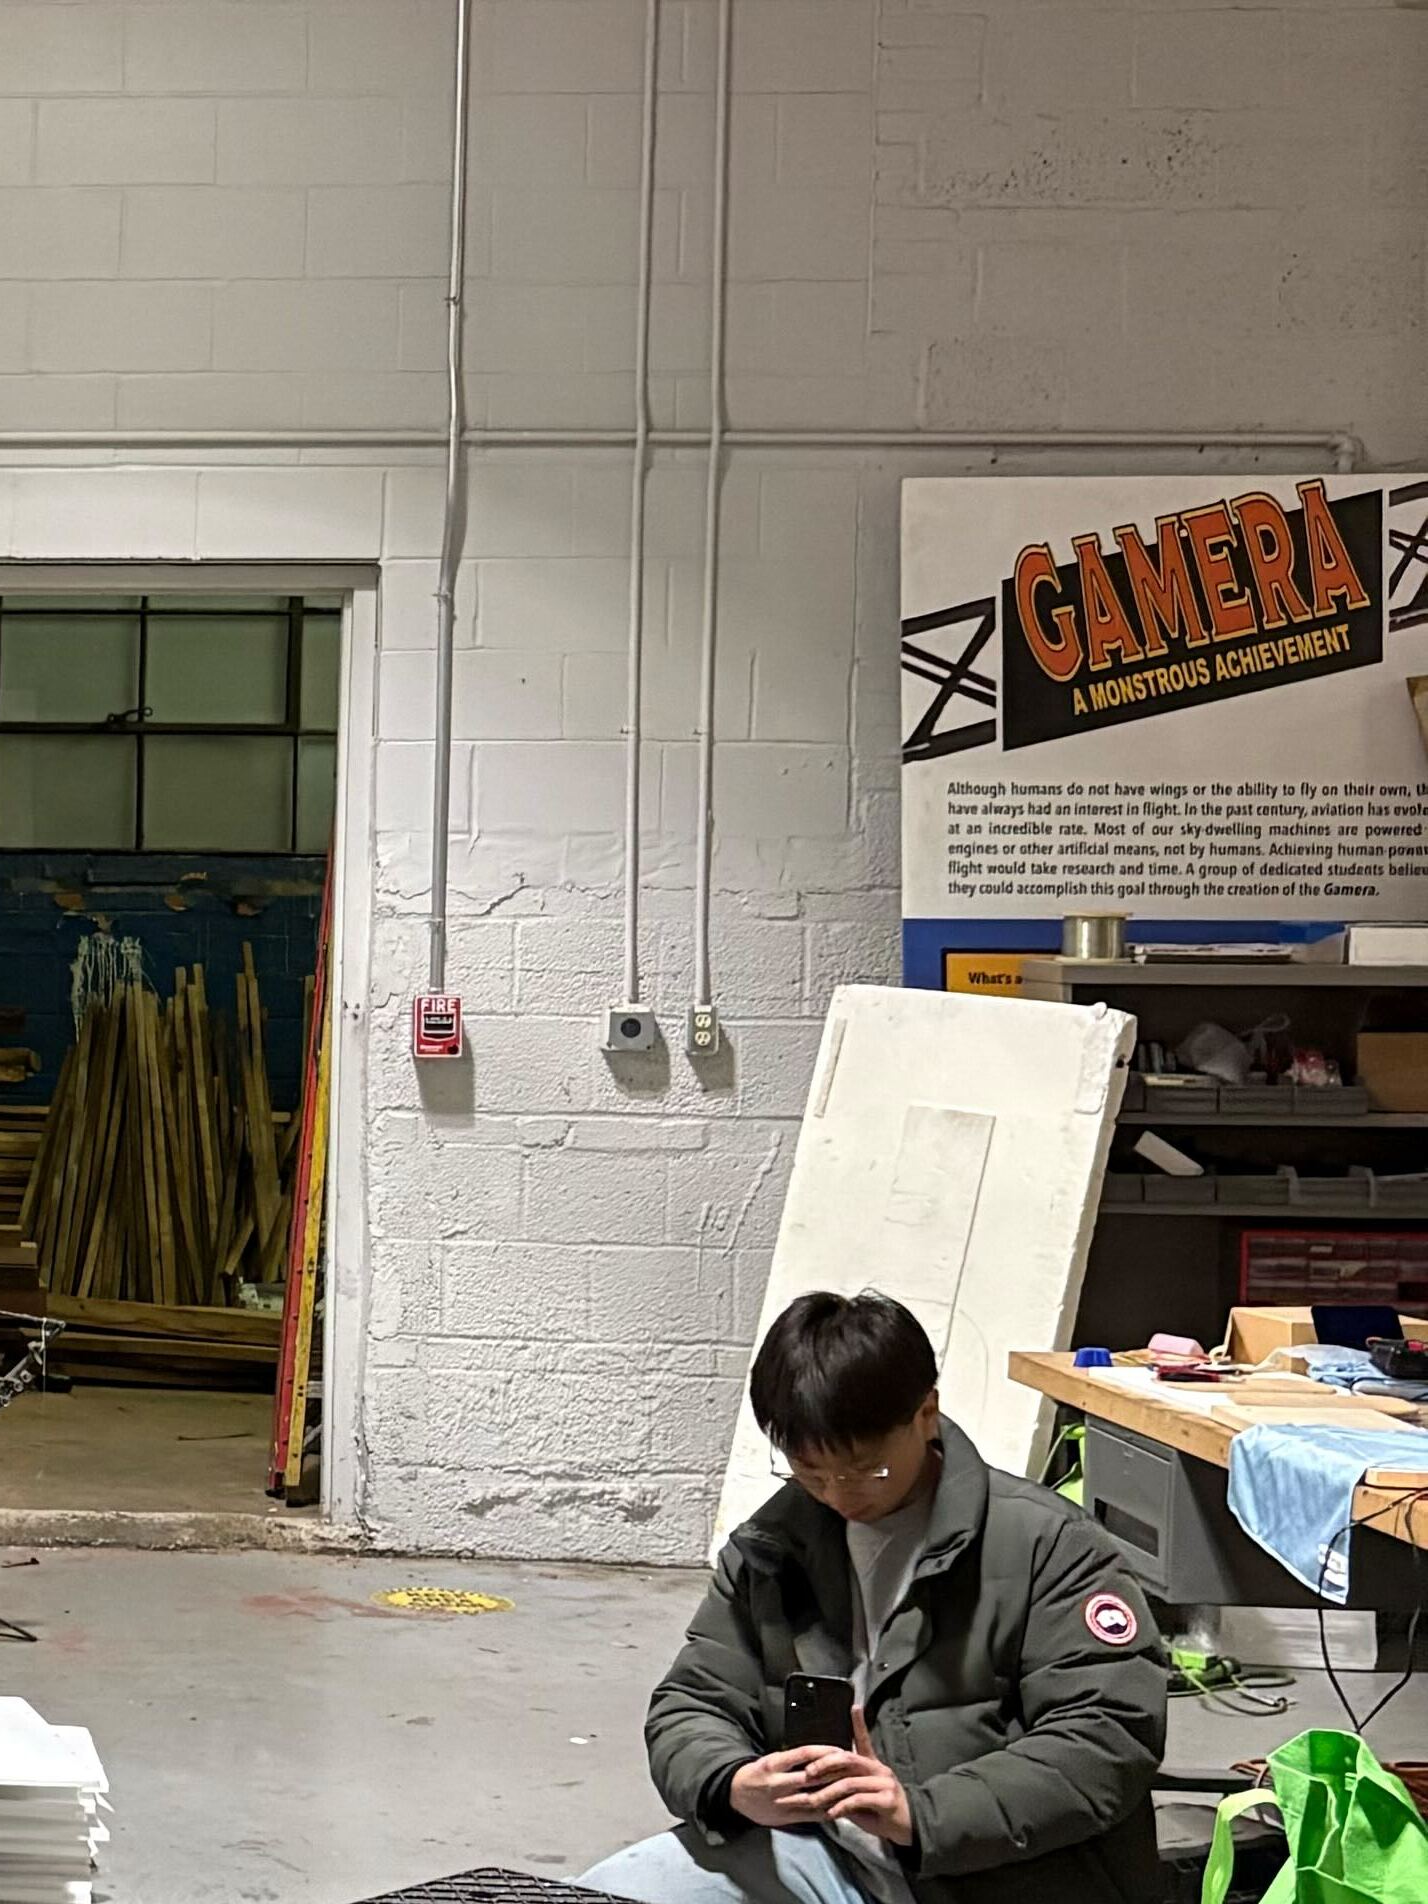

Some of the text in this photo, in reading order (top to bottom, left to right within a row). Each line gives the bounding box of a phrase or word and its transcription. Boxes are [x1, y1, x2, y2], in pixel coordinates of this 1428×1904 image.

[1014, 478, 1372, 684] GAMERA
[1072, 623, 1352, 716] A MONSTROUS ACHIEVEMENT
[947, 782, 1006, 799] Although
[1011, 782, 1062, 796] humans
[1066, 782, 1083, 796] do
[1088, 782, 1109, 796] not
[1115, 782, 1144, 796] have
[1150, 782, 1188, 799] wings
[1193, 786, 1206, 796] or
[1211, 782, 1232, 796] the
[1237, 782, 1278, 799] ability
[1283, 782, 1295, 796] to
[1300, 782, 1320, 799] fly
[1322, 786, 1338, 796] on
[1344, 782, 1374, 796] their
[1379, 786, 1411, 799] own,
[948, 803, 978, 816] have
[981, 803, 1024, 819] always
[1028, 803, 1051, 816] had
[1055, 807, 1071, 816] an
[1074, 803, 1122, 816] interest
[1127, 803, 1139, 816] in
[1143, 803, 1180, 819] flight.
[1185, 803, 1197, 816] In
[1201, 803, 1222, 816] the
[1226, 803, 1253, 819] past
[1256, 804, 1307, 820] century,
[1311, 804, 1363, 816] aviation
[1368, 804, 1390, 816] has
[948, 822, 960, 835] at
[966, 826, 982, 835] an
[989, 823, 1052, 835] incredible
[1059, 823, 1088, 835] rate.
[1094, 823, 1125, 835] Most
[1132, 823, 1145, 835] of
[1152, 826, 1173, 835] our
[1269, 823, 1330, 836] machines
[1338, 827, 1358, 836] are
[1365, 823, 1422, 839] powered
[948, 842, 998, 858] engines
[1003, 846, 1015, 855] or
[1020, 842, 1053, 855] other
[1058, 842, 1109, 855] artificial
[1113, 846, 1159, 858] means,
[1164, 842, 1185, 855] not
[1189, 843, 1205, 859] by
[1269, 843, 1333, 859] Achieving
[948, 862, 982, 878] flight
[987, 862, 1025, 875] would
[1031, 862, 1057, 875] take
[1063, 862, 1114, 875] research
[1119, 862, 1143, 875] and
[1149, 862, 1181, 875] time.
[1186, 862, 1195, 875] A
[1199, 865, 1237, 878] group
[1242, 862, 1256, 875] of
[1260, 862, 1323, 875] dedicated
[1328, 862, 1385, 875] students
[948, 882, 976, 898] they
[979, 882, 1014, 895] could
[1017, 882, 1087, 898] accomplish
[1091, 882, 1114, 895] this
[1118, 882, 1144, 898] goal
[1149, 882, 1200, 898] through
[1204, 882, 1224, 895] the
[1227, 882, 1279, 895] creation
[1283, 883, 1296, 895] of
[1299, 883, 1321, 895] the
[420, 998, 457, 1013] FIRE
